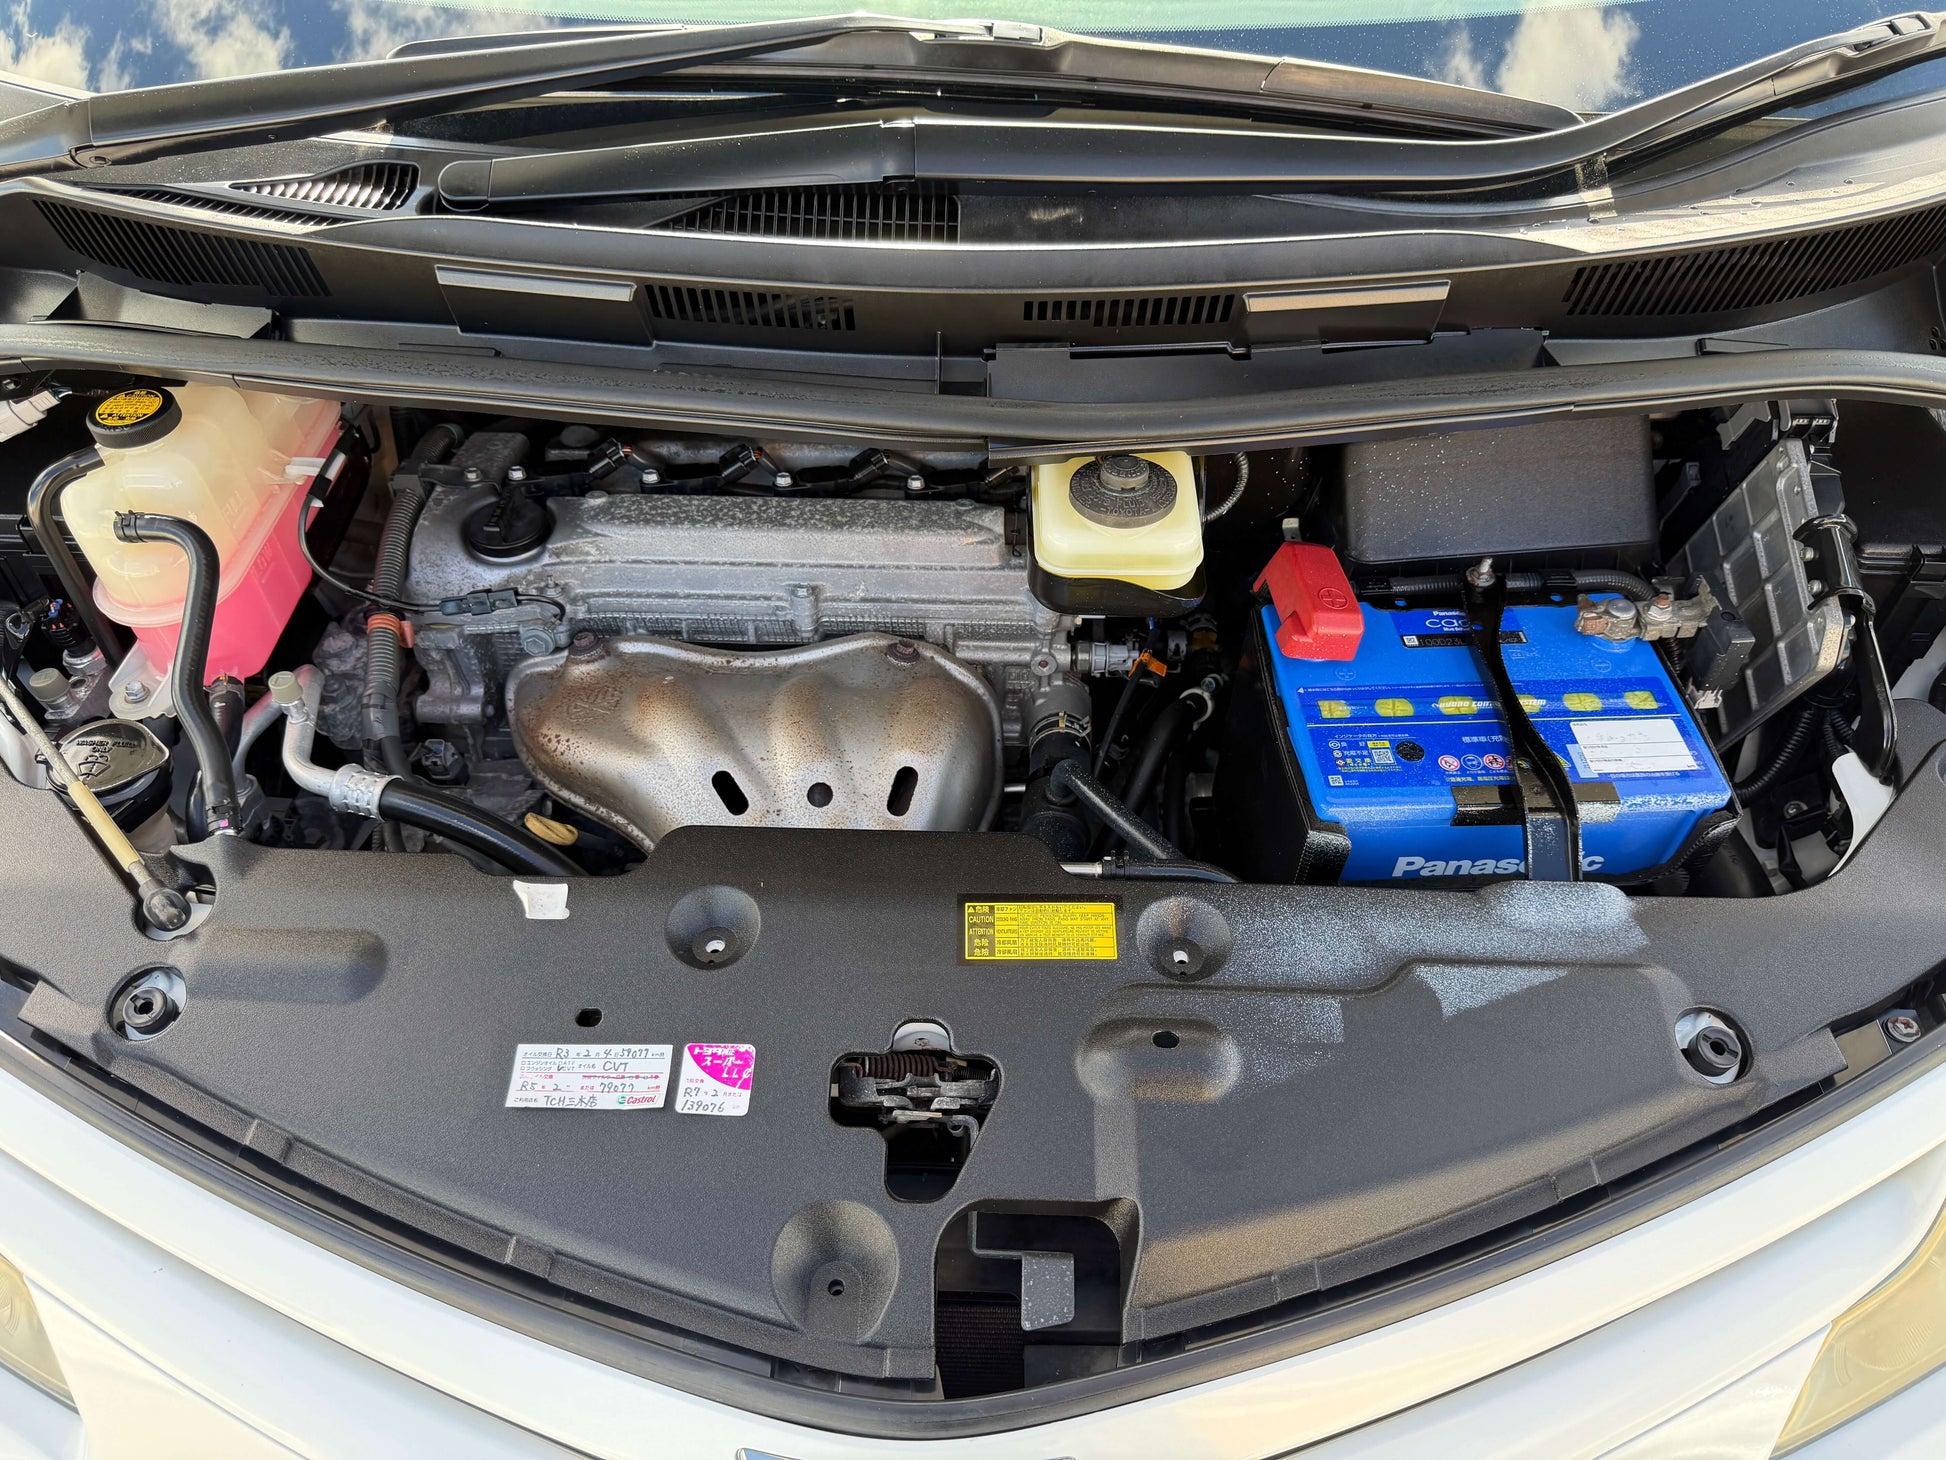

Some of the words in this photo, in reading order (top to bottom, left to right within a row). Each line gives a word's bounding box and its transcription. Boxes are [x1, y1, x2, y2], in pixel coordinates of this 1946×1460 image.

[968, 915, 994, 924] CAUTION
[968, 928, 994, 936] ATTENTION
[602, 1060, 629, 1072] CVT
[520, 1080, 539, 1091] R5
[683, 1086, 701, 1098] R7
[710, 1088, 719, 1097] 2
[626, 1095, 656, 1105] Castrol
